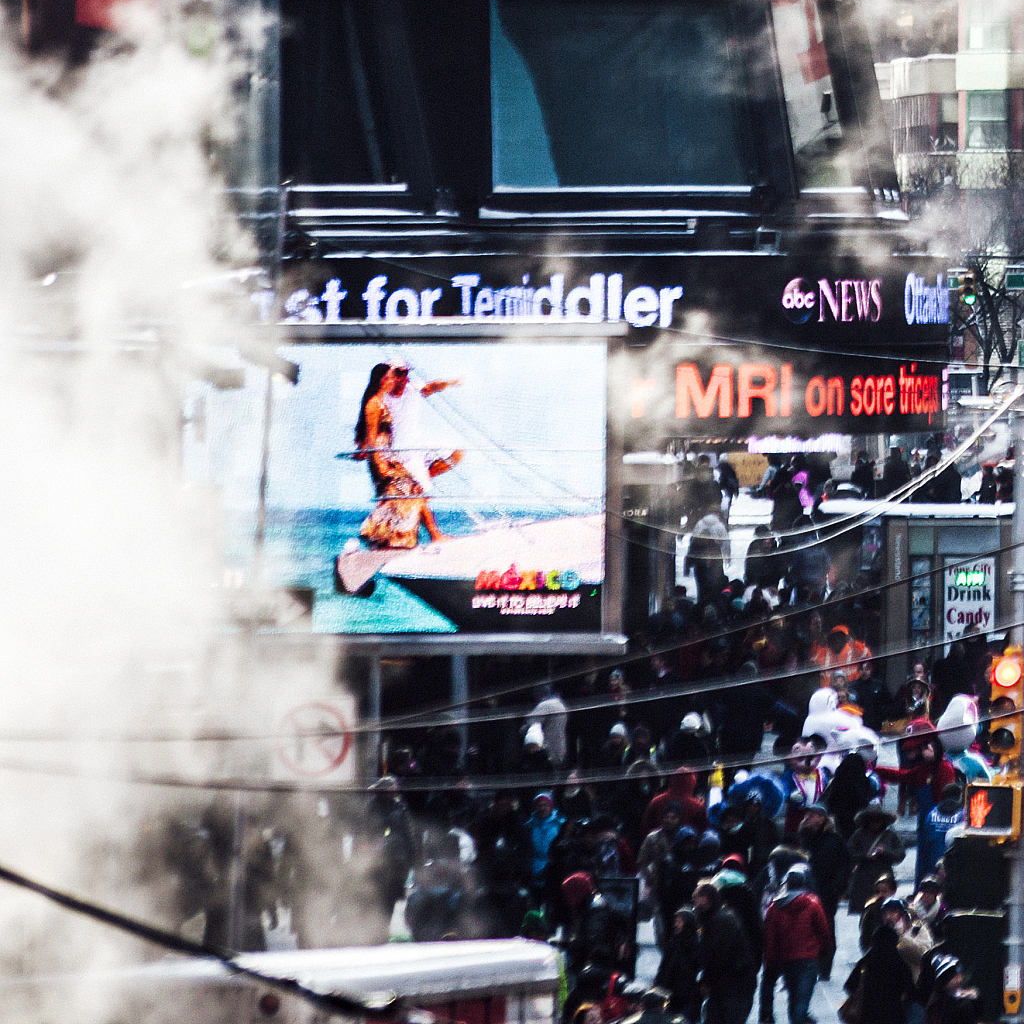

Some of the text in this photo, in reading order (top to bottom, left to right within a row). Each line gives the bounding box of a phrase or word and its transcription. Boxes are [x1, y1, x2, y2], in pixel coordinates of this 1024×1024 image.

[362, 275, 442, 318] for
[818, 279, 882, 322] NEWS
[676, 362, 793, 418] MRI
[806, 375, 844, 417] on
[850, 375, 896, 417] sore
[899, 362, 938, 424] triceps
[948, 586, 991, 601] Drink
[946, 608, 990, 628] Candy
